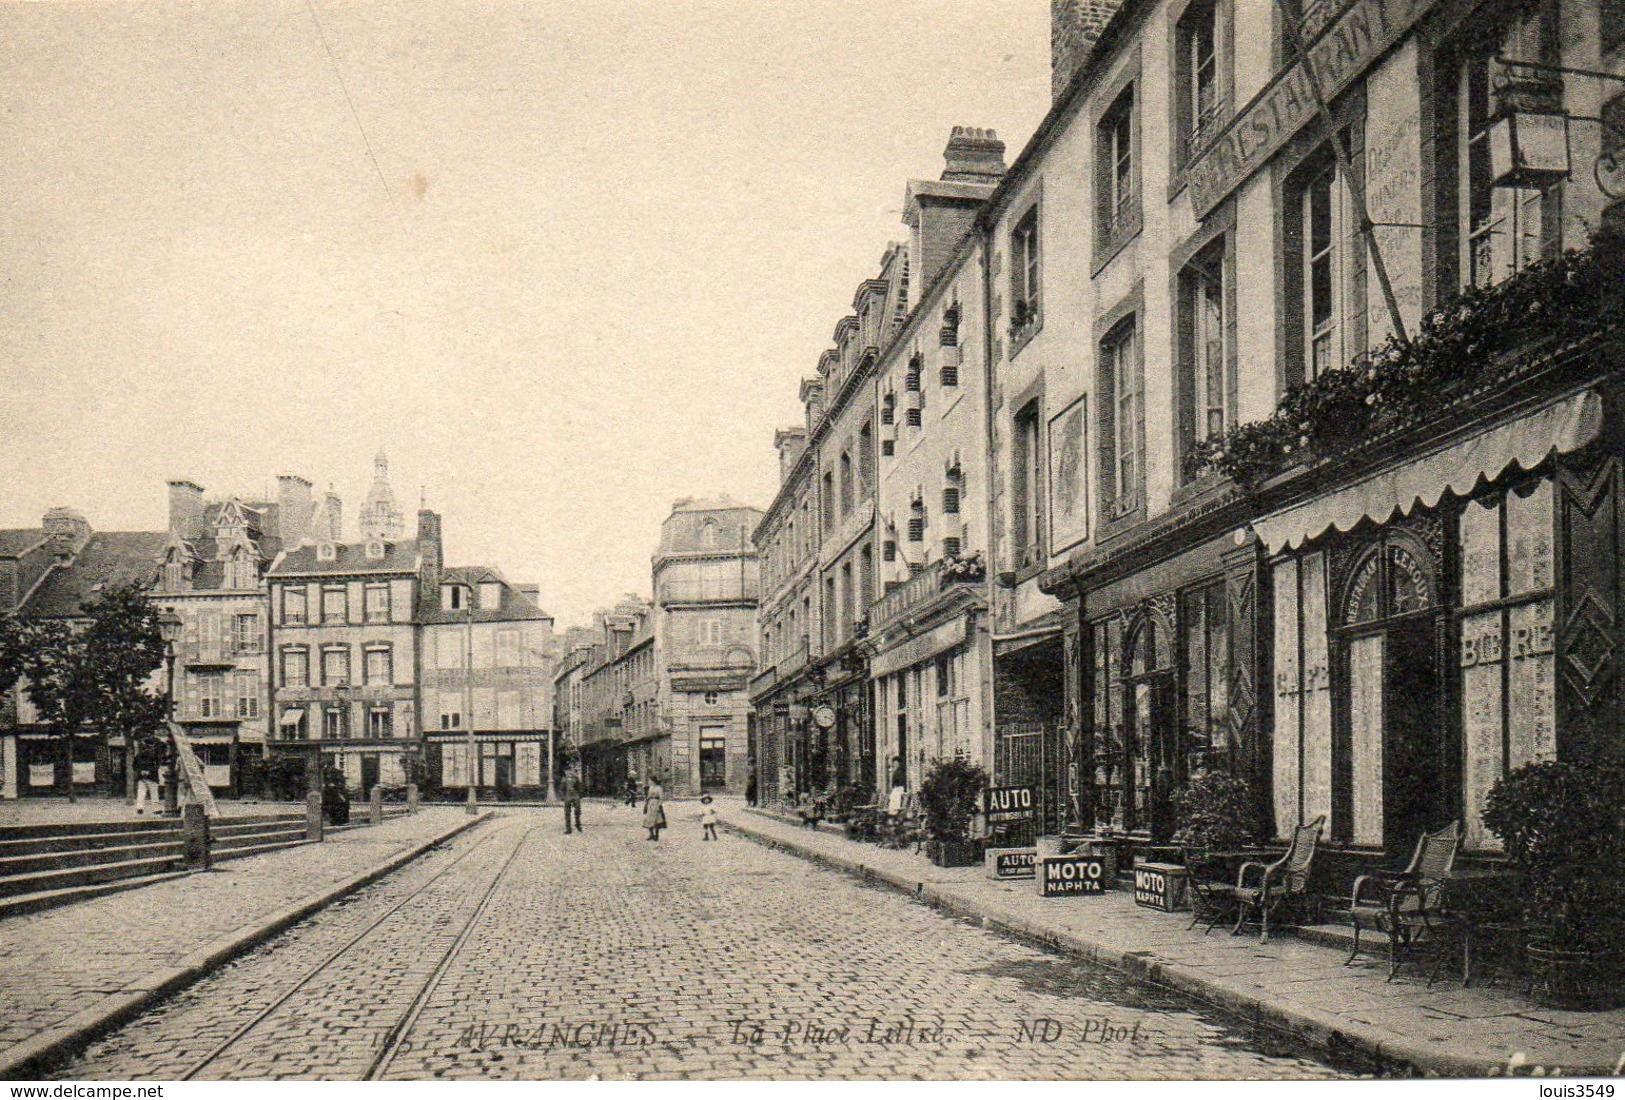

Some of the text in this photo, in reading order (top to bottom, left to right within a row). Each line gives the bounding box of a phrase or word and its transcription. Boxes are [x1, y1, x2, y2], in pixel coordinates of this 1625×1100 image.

[1394, 549, 1428, 608] LEROUX
[990, 789, 1030, 810] AUTO
[1003, 855, 1035, 866] AUTO
[1048, 862, 1101, 879] MOTO
[1048, 881, 1100, 891] NAPHTA
[1136, 870, 1165, 893] MOTO
[1136, 891, 1164, 906] NAPHTA
